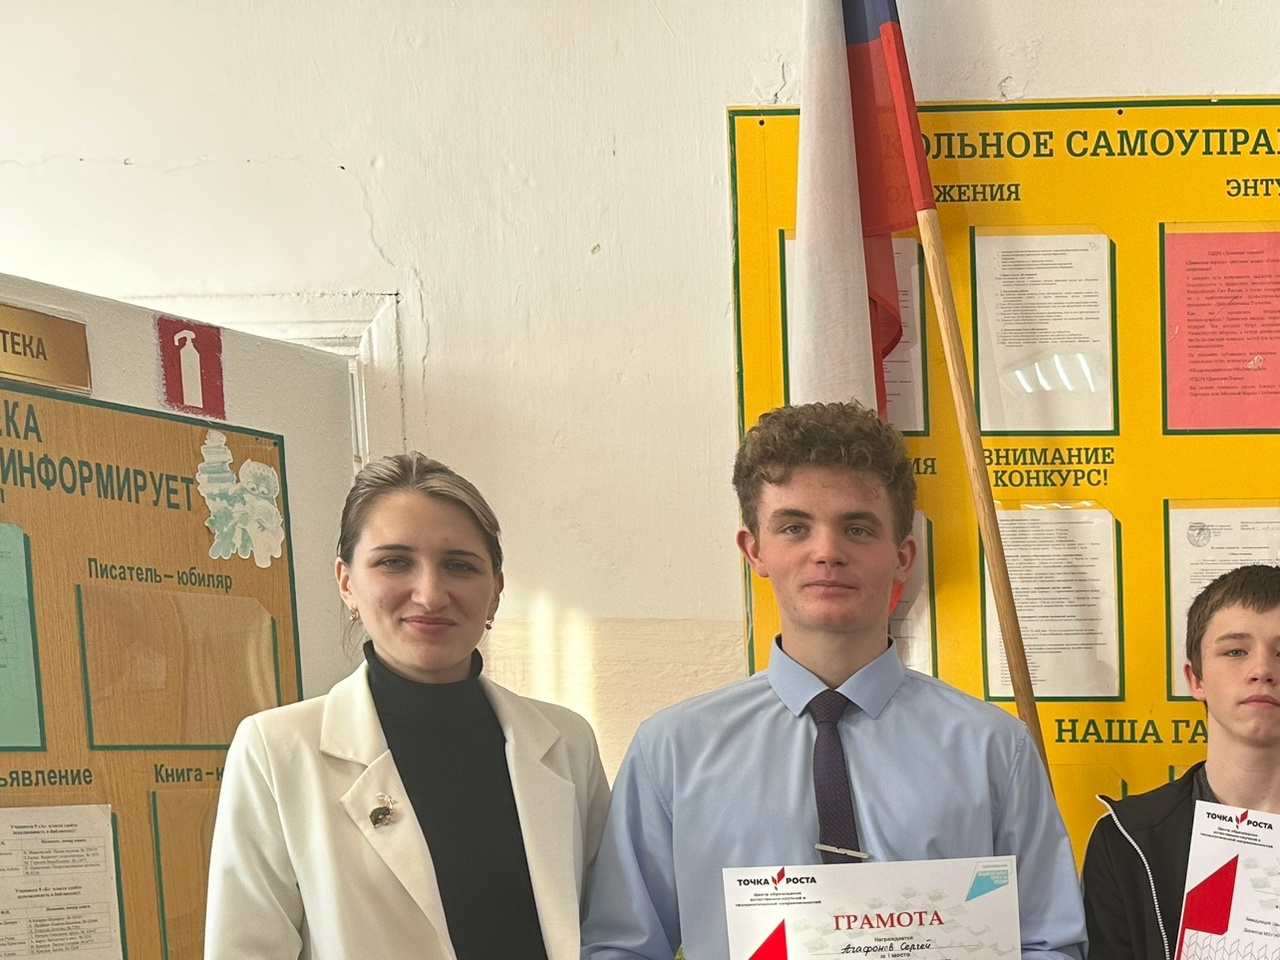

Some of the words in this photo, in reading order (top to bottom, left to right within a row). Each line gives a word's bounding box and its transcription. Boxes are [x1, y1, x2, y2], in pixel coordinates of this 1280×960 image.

[921, 131, 1053, 159] ЛЬНОЕ
[933, 183, 1021, 202] ЖЕНИЯ
[0, 329, 48, 361] ТЕКА
[983, 447, 1115, 466] ВНИМАНИЕ
[0, 446, 194, 512] ИНФОРМИРУЕТ
[992, 469, 1108, 487] КОНКУРС!
[177, 566, 232, 593] юбиляр
[1054, 718, 1164, 744] НАША
[1206, 812, 1234, 823] ТОЧКА
[1246, 820, 1273, 830] РОСТА
[737, 878, 770, 886] ТОЧКА
[786, 876, 817, 884] РОСТА
[833, 910, 944, 930] ГРАМОТА
[840, 942, 894, 956] Агафонов
[900, 939, 931, 952] Сергей
